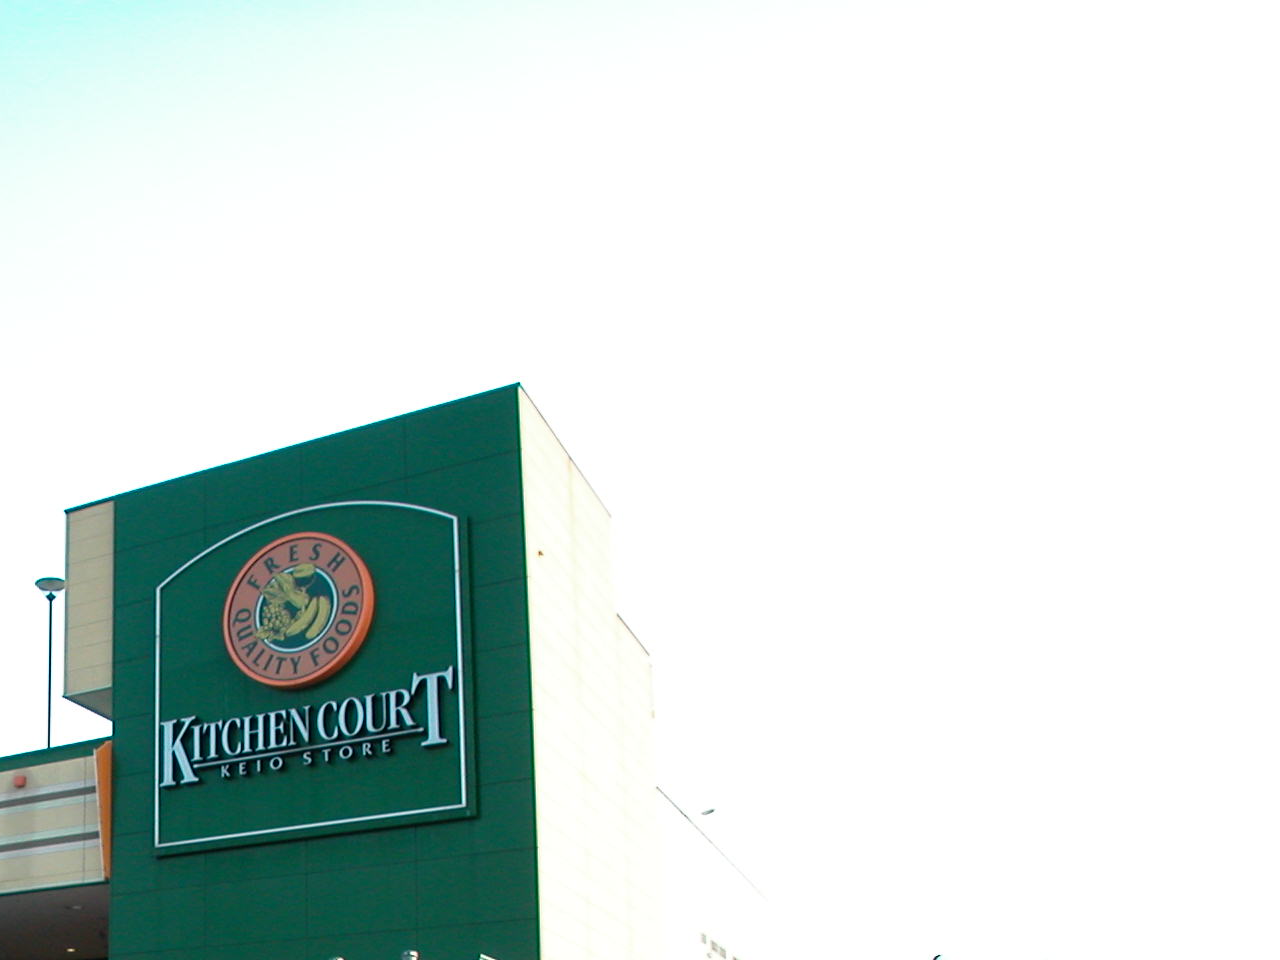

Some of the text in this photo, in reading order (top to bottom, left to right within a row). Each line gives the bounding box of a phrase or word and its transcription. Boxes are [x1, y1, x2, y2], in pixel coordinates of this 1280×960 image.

[247, 543, 347, 592] FRESH
[231, 583, 361, 676] QUALITY FOODS
[317, 665, 454, 748] COURT
[220, 737, 392, 779] KEIO STORE
